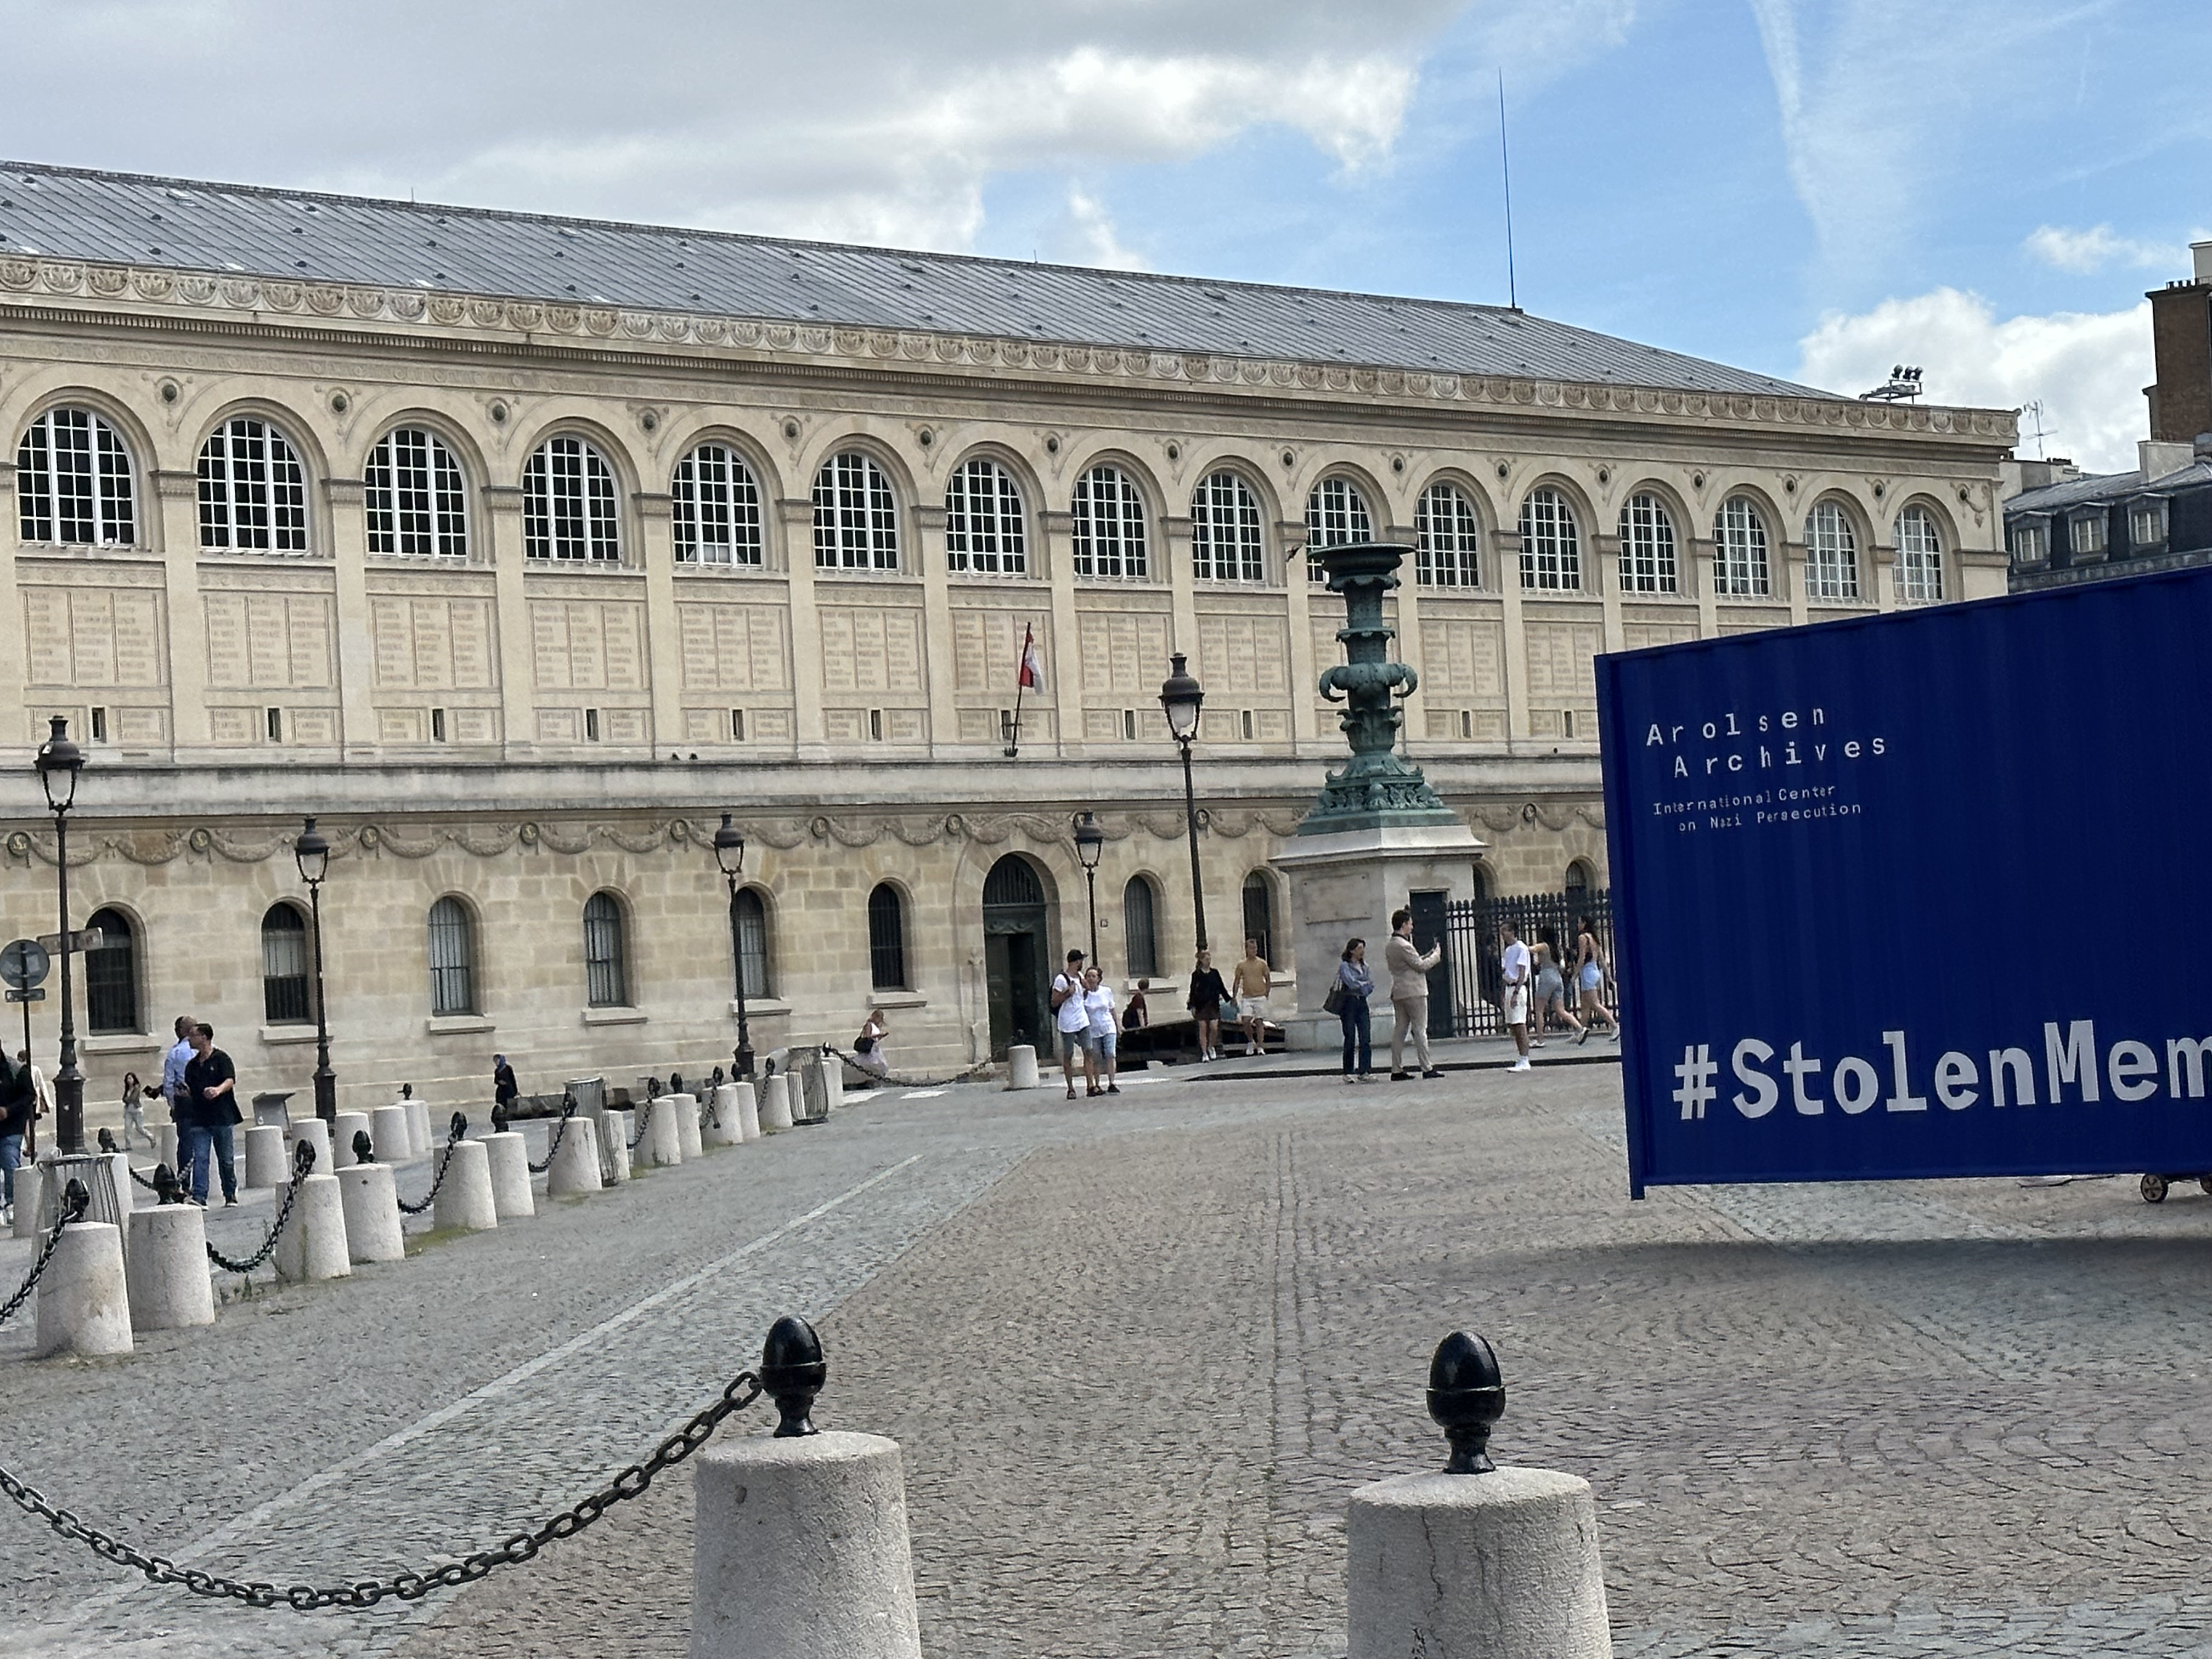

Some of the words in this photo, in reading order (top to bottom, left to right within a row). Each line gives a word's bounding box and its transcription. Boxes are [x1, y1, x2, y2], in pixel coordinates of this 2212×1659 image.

[1646, 708, 1825, 747] Arolsen
[1674, 737, 1886, 778] Archives
[1653, 790, 1771, 816] International
[1779, 785, 1835, 802] Center
[1679, 822, 1696, 832] on
[1710, 816, 1742, 830] Nazi
[1757, 803, 1861, 824] Persecution
[1672, 1019, 2212, 1120] #StolenMem
